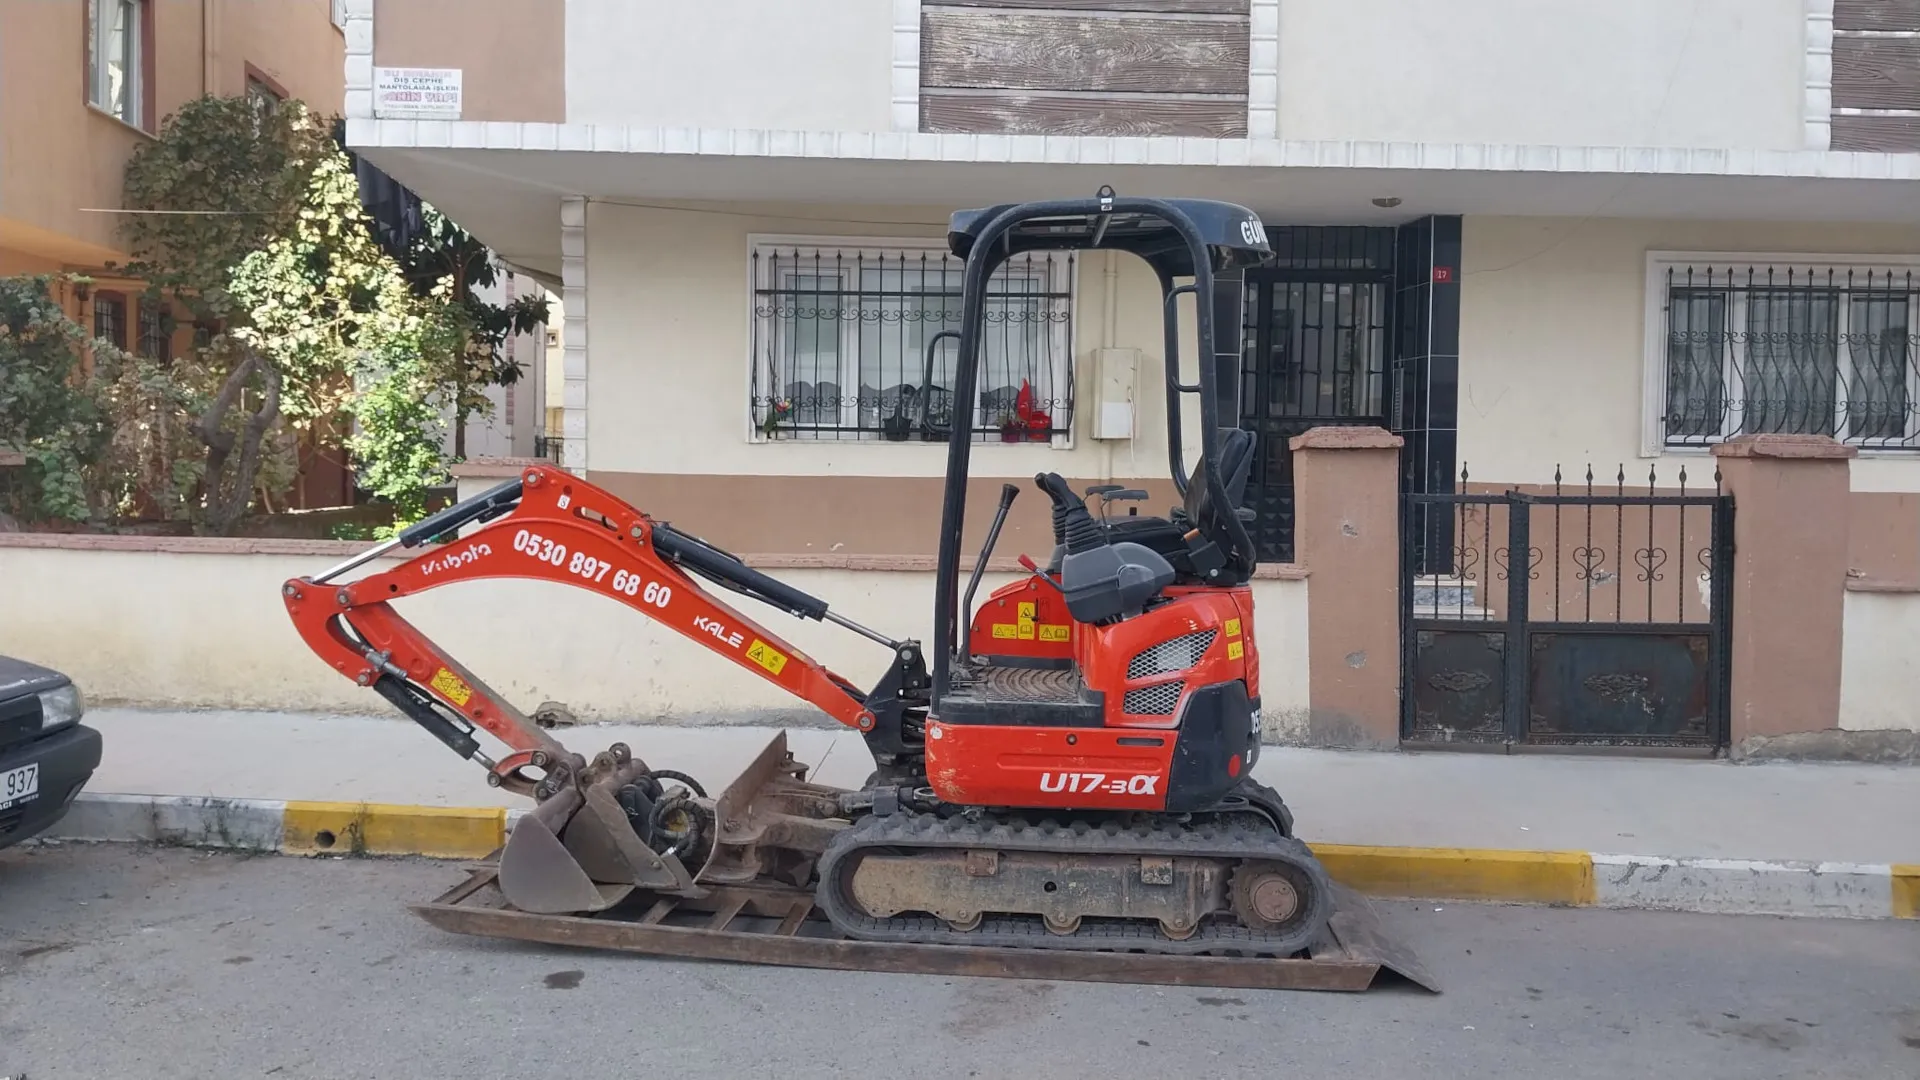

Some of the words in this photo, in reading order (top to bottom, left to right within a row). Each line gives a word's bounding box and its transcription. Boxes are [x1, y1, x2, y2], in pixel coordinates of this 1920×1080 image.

[513, 529, 567, 567] 0530
[569, 552, 612, 583] 897
[612, 569, 641, 596] 68
[643, 581, 672, 608] 60
[693, 615, 744, 649] KALE
[7, 766, 36, 796] 937
